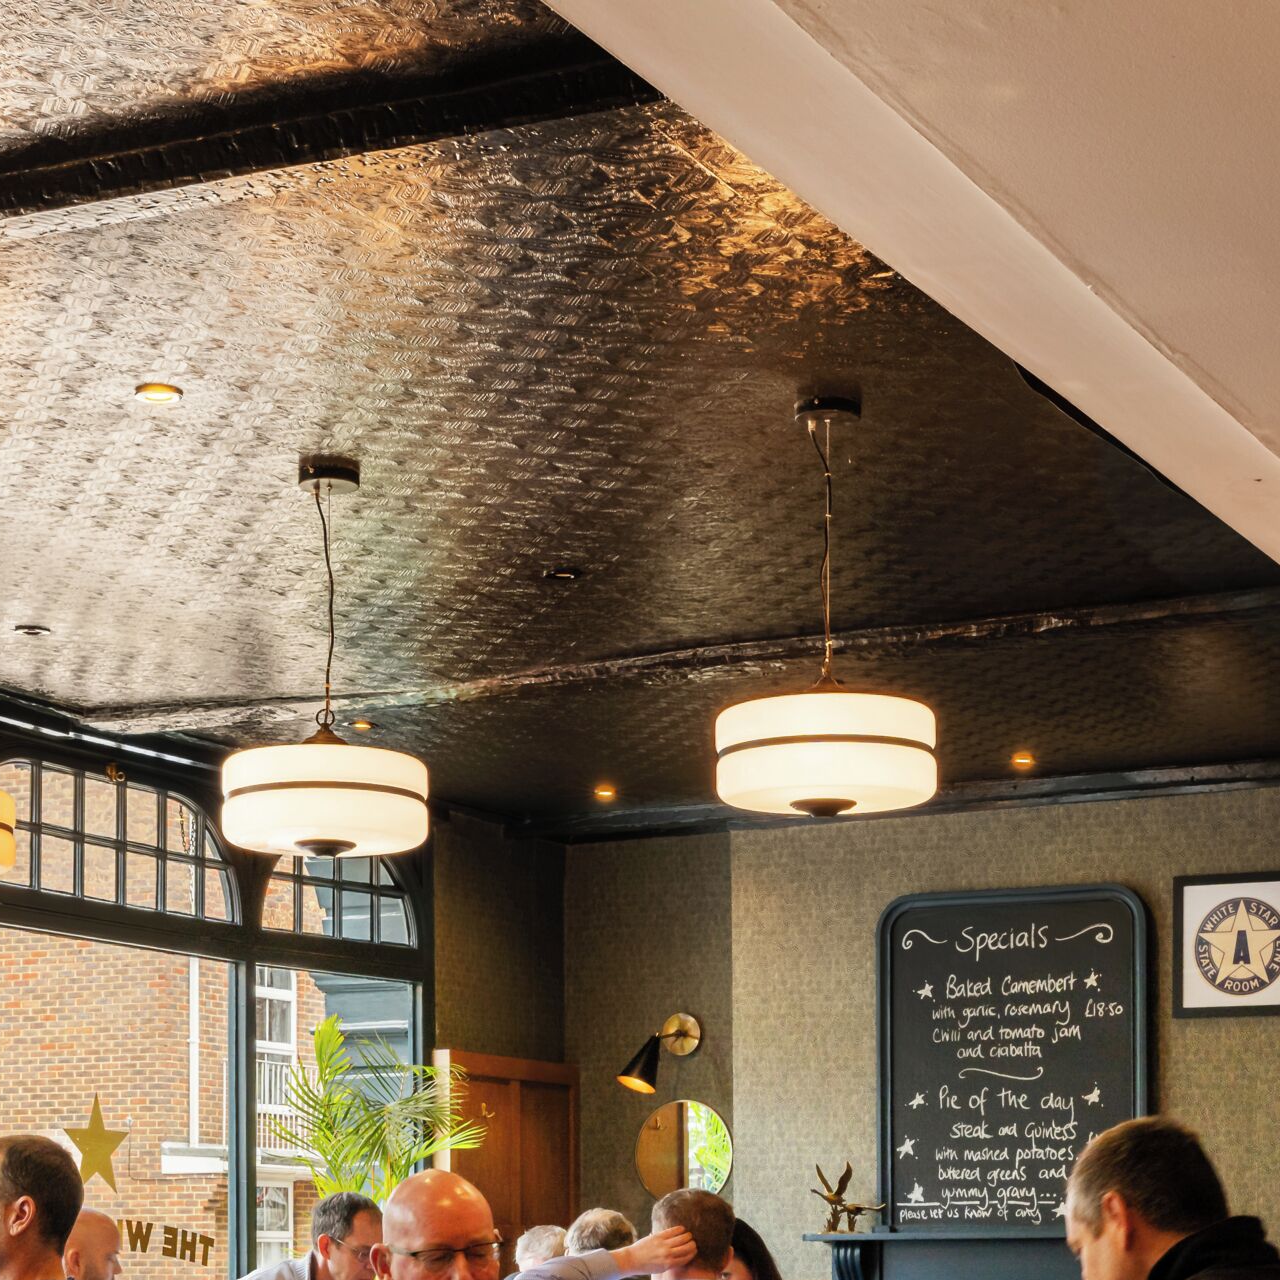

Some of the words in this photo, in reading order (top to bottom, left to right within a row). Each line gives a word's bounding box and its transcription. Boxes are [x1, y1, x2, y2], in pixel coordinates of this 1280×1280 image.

[1203, 903, 1236, 932] WHITE
[1249, 902, 1279, 927] STAR
[955, 923, 1049, 962] Specials
[1198, 944, 1217, 979] STATE
[1224, 978, 1260, 992] ROOM
[946, 974, 992, 999] Baked
[1001, 971, 1077, 996] Camembert
[932, 1004, 956, 1020] with
[1004, 1001, 1070, 1025] rosemary
[967, 1025, 995, 1041] and
[999, 1024, 1045, 1041] tomato
[1051, 1021, 1081, 1044] jam
[957, 1043, 984, 1059] and
[990, 1041, 1042, 1058] ciabatta
[939, 1085, 962, 1109] Pie
[968, 1086, 989, 1116] of
[1041, 1092, 1075, 1125] day
[998, 1123, 1018, 1137] and
[935, 1147, 958, 1161] with
[964, 1147, 1009, 1161] mashed
[938, 1165, 980, 1181] buttered
[987, 1166, 1027, 1187] greens
[1039, 1165, 1067, 1180] and
[940, 1186, 989, 1210] yummy
[900, 1208, 928, 1223] please
[930, 1208, 944, 1219] let
[947, 1208, 960, 1219] us
